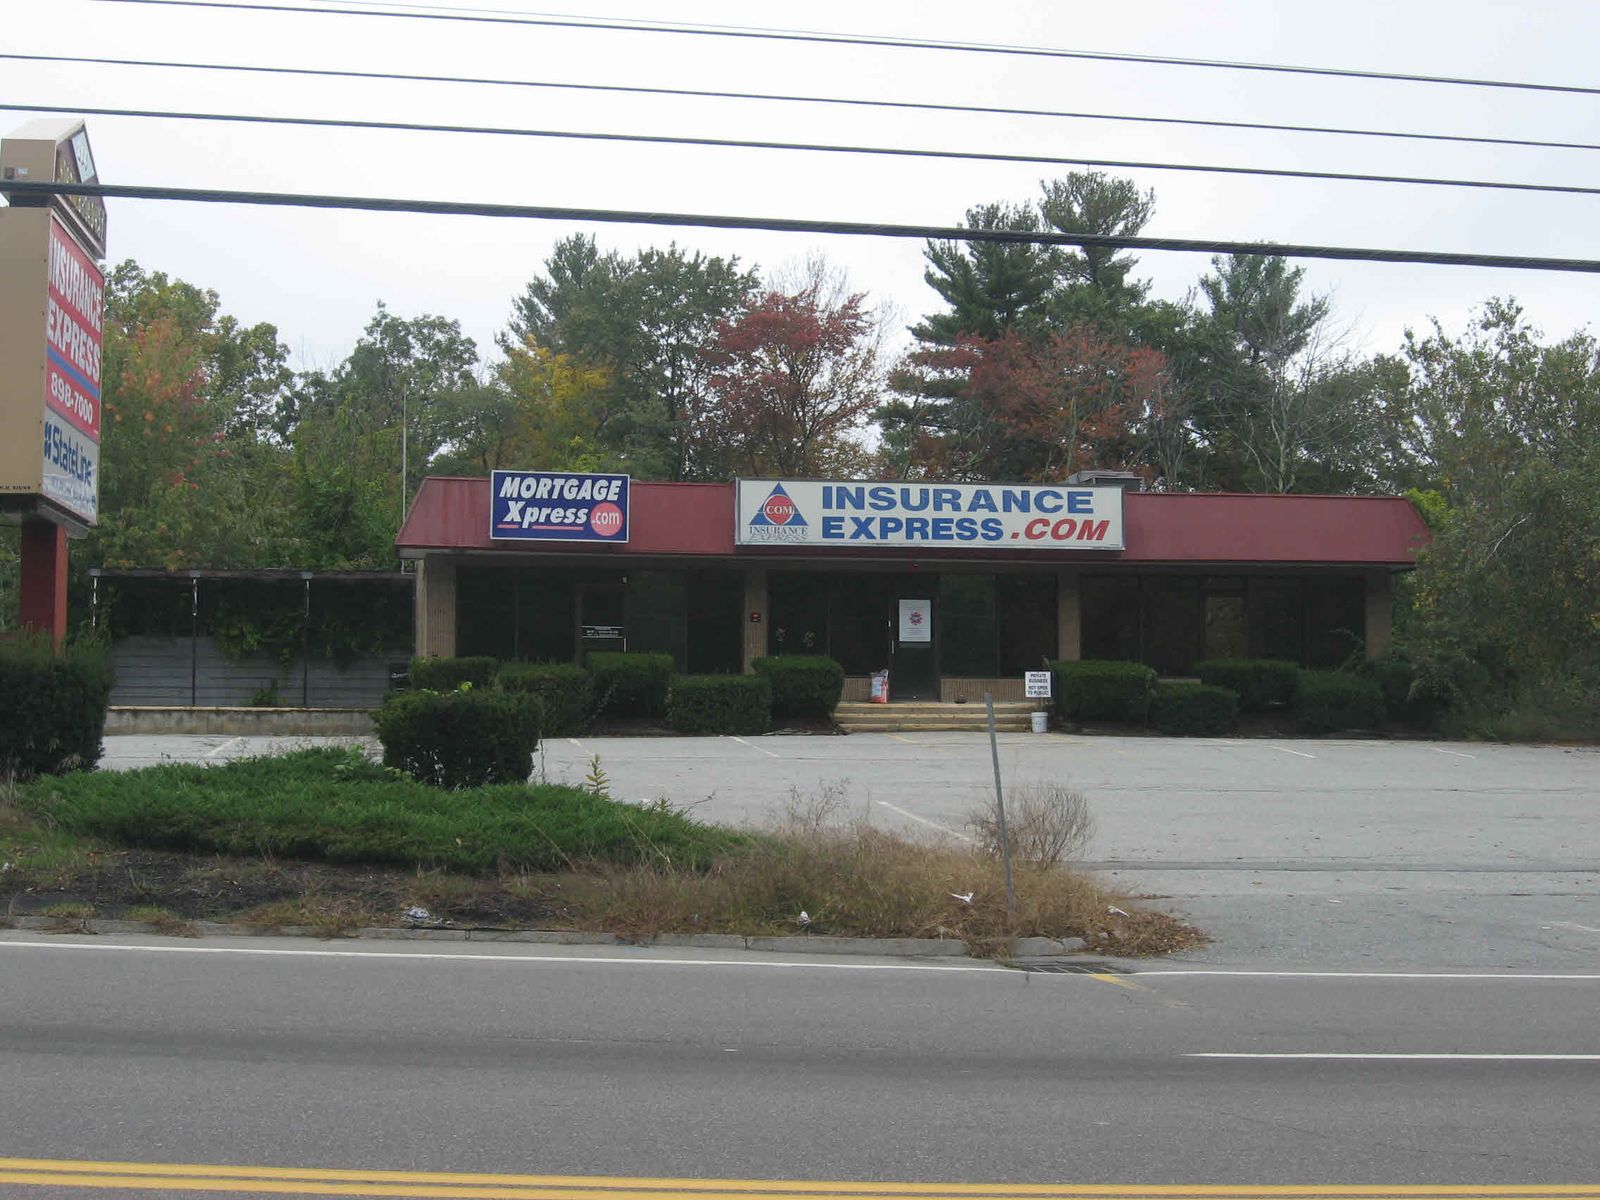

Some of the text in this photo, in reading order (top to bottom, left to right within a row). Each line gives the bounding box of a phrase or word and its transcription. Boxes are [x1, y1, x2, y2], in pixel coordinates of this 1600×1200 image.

[50, 233, 102, 333] INSURANCE
[48, 297, 101, 383] EXPRESS
[51, 372, 93, 425] 898-7000
[499, 476, 622, 501] MORTGAGE
[822, 485, 1094, 515] INSURANCE
[766, 505, 794, 515] COM
[750, 526, 808, 535] INSURANCE
